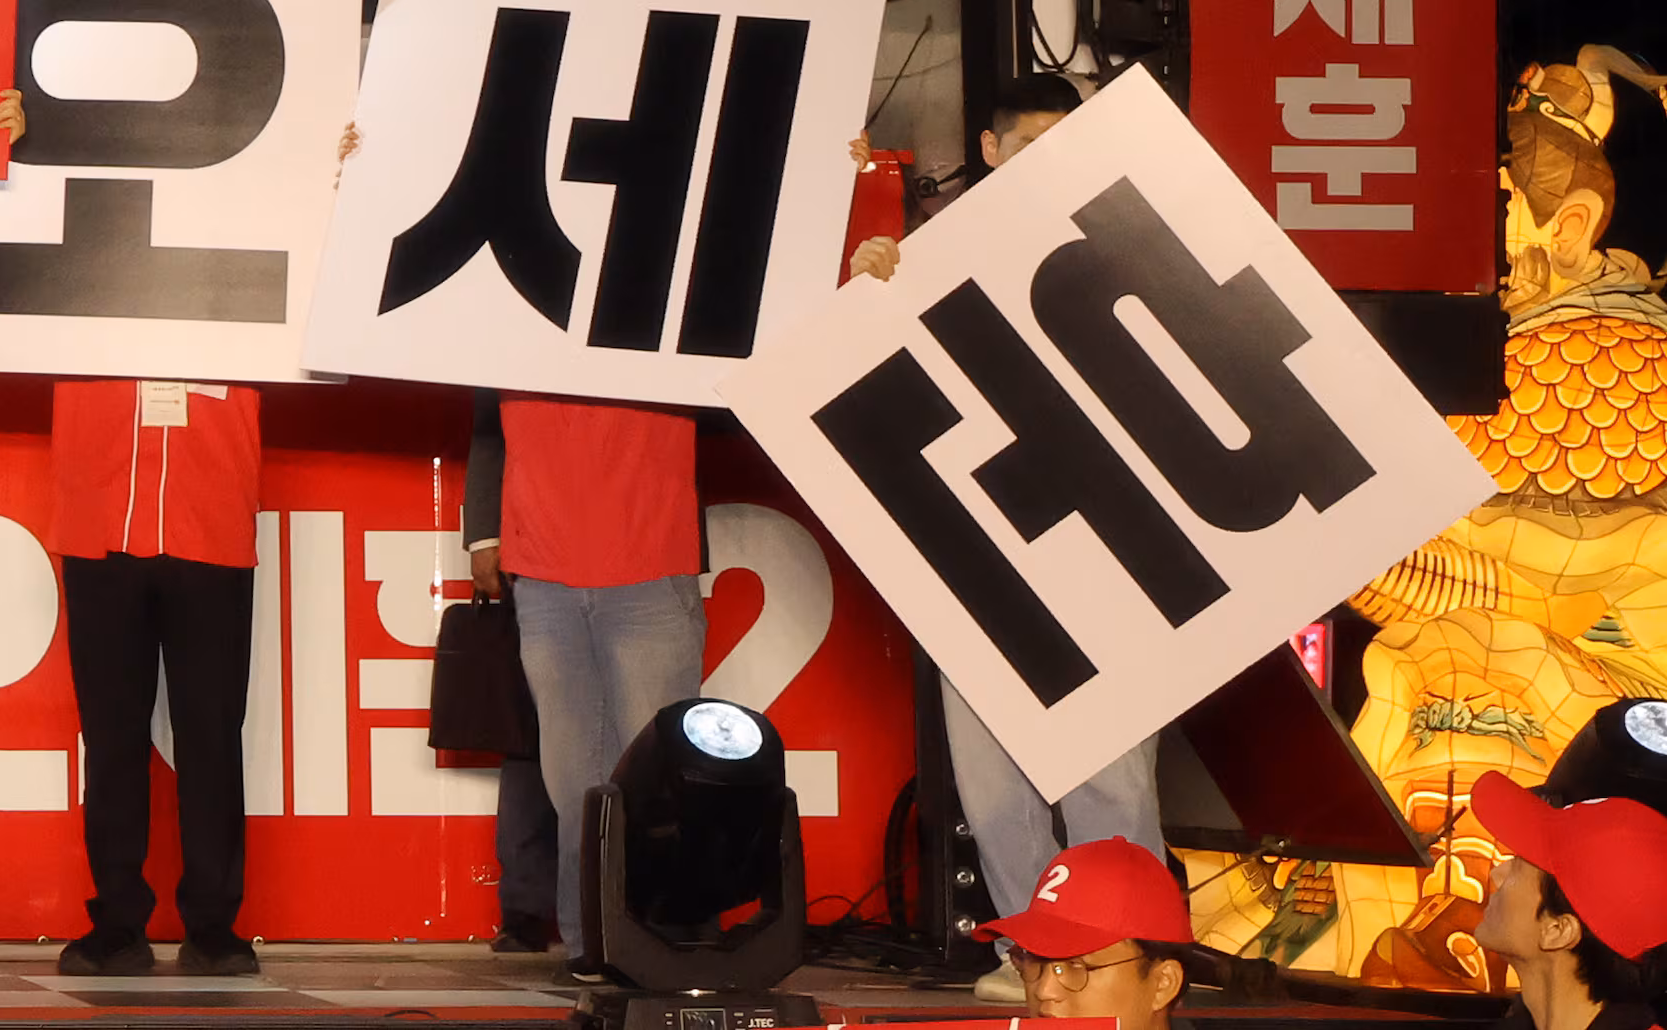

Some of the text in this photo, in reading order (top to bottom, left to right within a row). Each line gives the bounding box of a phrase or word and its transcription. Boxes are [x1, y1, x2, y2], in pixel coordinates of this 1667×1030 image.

[377, 7, 811, 359] 세
[809, 175, 1377, 710] 훈
[1038, 864, 1069, 904] 2
